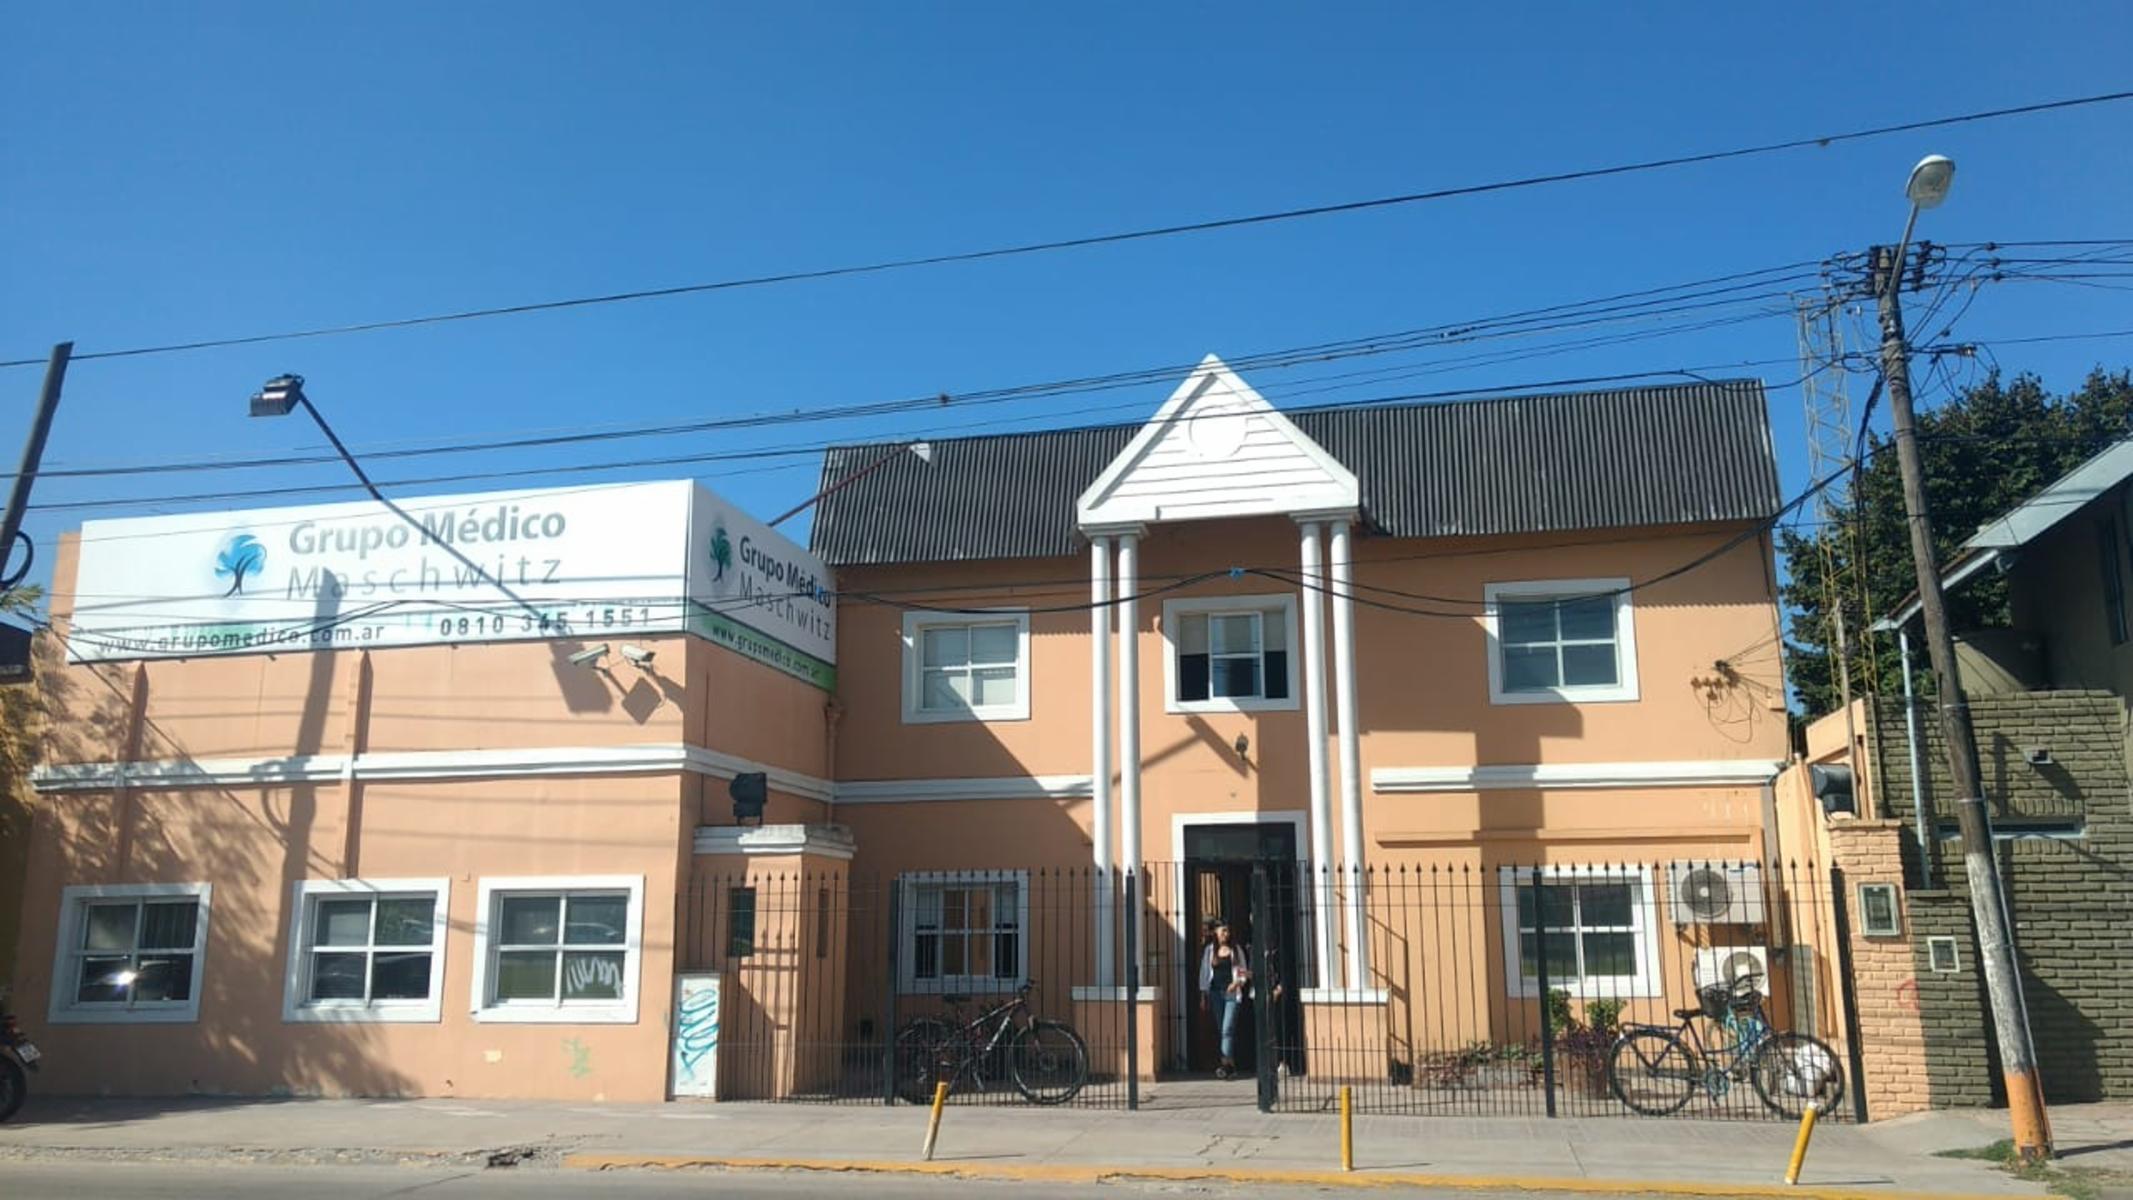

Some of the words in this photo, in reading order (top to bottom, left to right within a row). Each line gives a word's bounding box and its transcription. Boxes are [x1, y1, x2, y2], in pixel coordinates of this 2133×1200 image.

[288, 520, 409, 560] Grupo
[419, 506, 566, 547] Médico
[286, 554, 561, 600] Maschwitz
[740, 535, 784, 582] Grupo
[440, 617, 504, 636] 0810
[586, 608, 650, 628] 1551
[739, 571, 830, 641] Maschwitz
